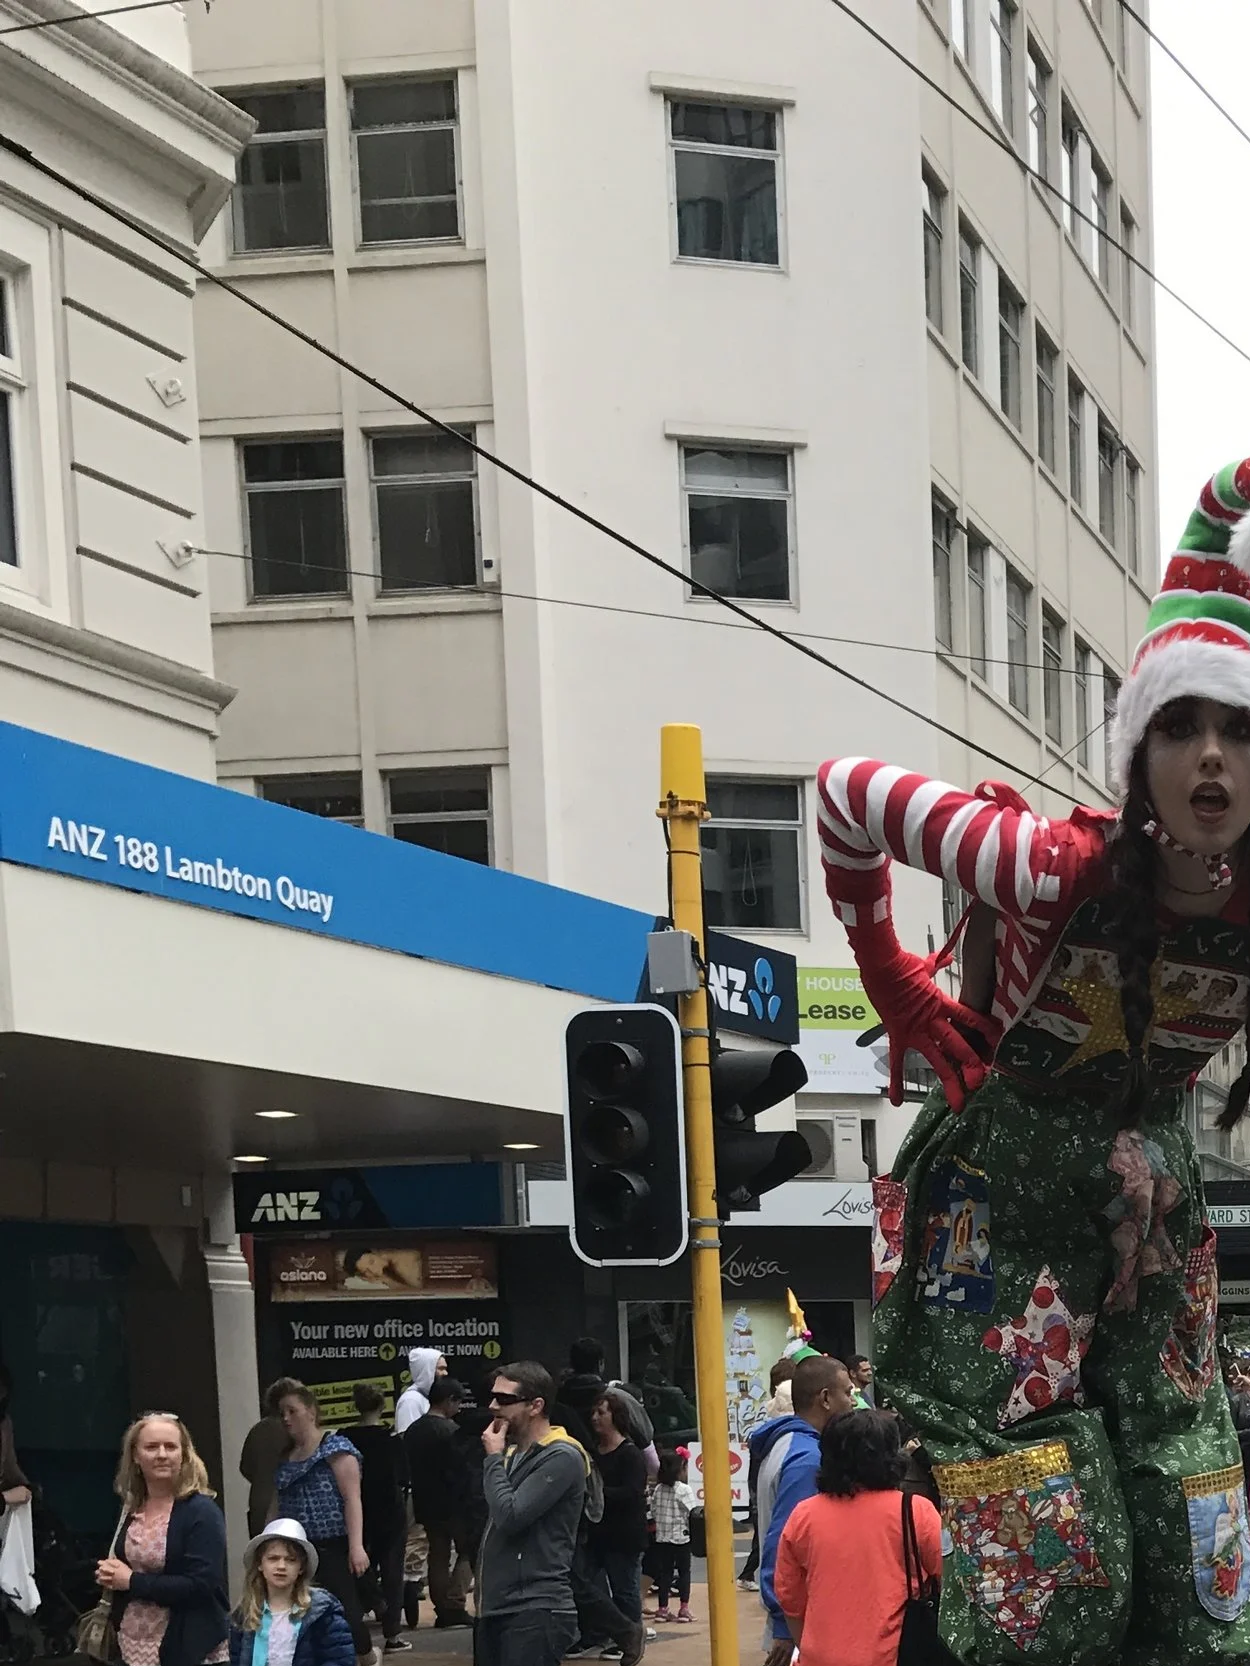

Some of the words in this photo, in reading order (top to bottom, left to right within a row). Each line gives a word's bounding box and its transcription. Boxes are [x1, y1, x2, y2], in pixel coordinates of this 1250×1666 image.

[48, 815, 108, 861] ANZ
[113, 834, 159, 873] 188
[165, 846, 272, 901] Lambton
[276, 875, 334, 923] Quay
[708, 961, 749, 1016] NZ
[250, 1191, 321, 1223] ANZ
[1208, 1210, 1233, 1223] ARD
[720, 1244, 790, 1287] Lovisa
[290, 1321, 330, 1341] Your
[334, 1324, 370, 1339] new
[373, 1319, 424, 1339] office
[428, 1317, 500, 1337] location
[292, 1347, 348, 1359] AVAILABLE
[350, 1347, 378, 1358] HERE
[456, 1344, 483, 1356] NOW
[696, 1488, 741, 1500] ON
